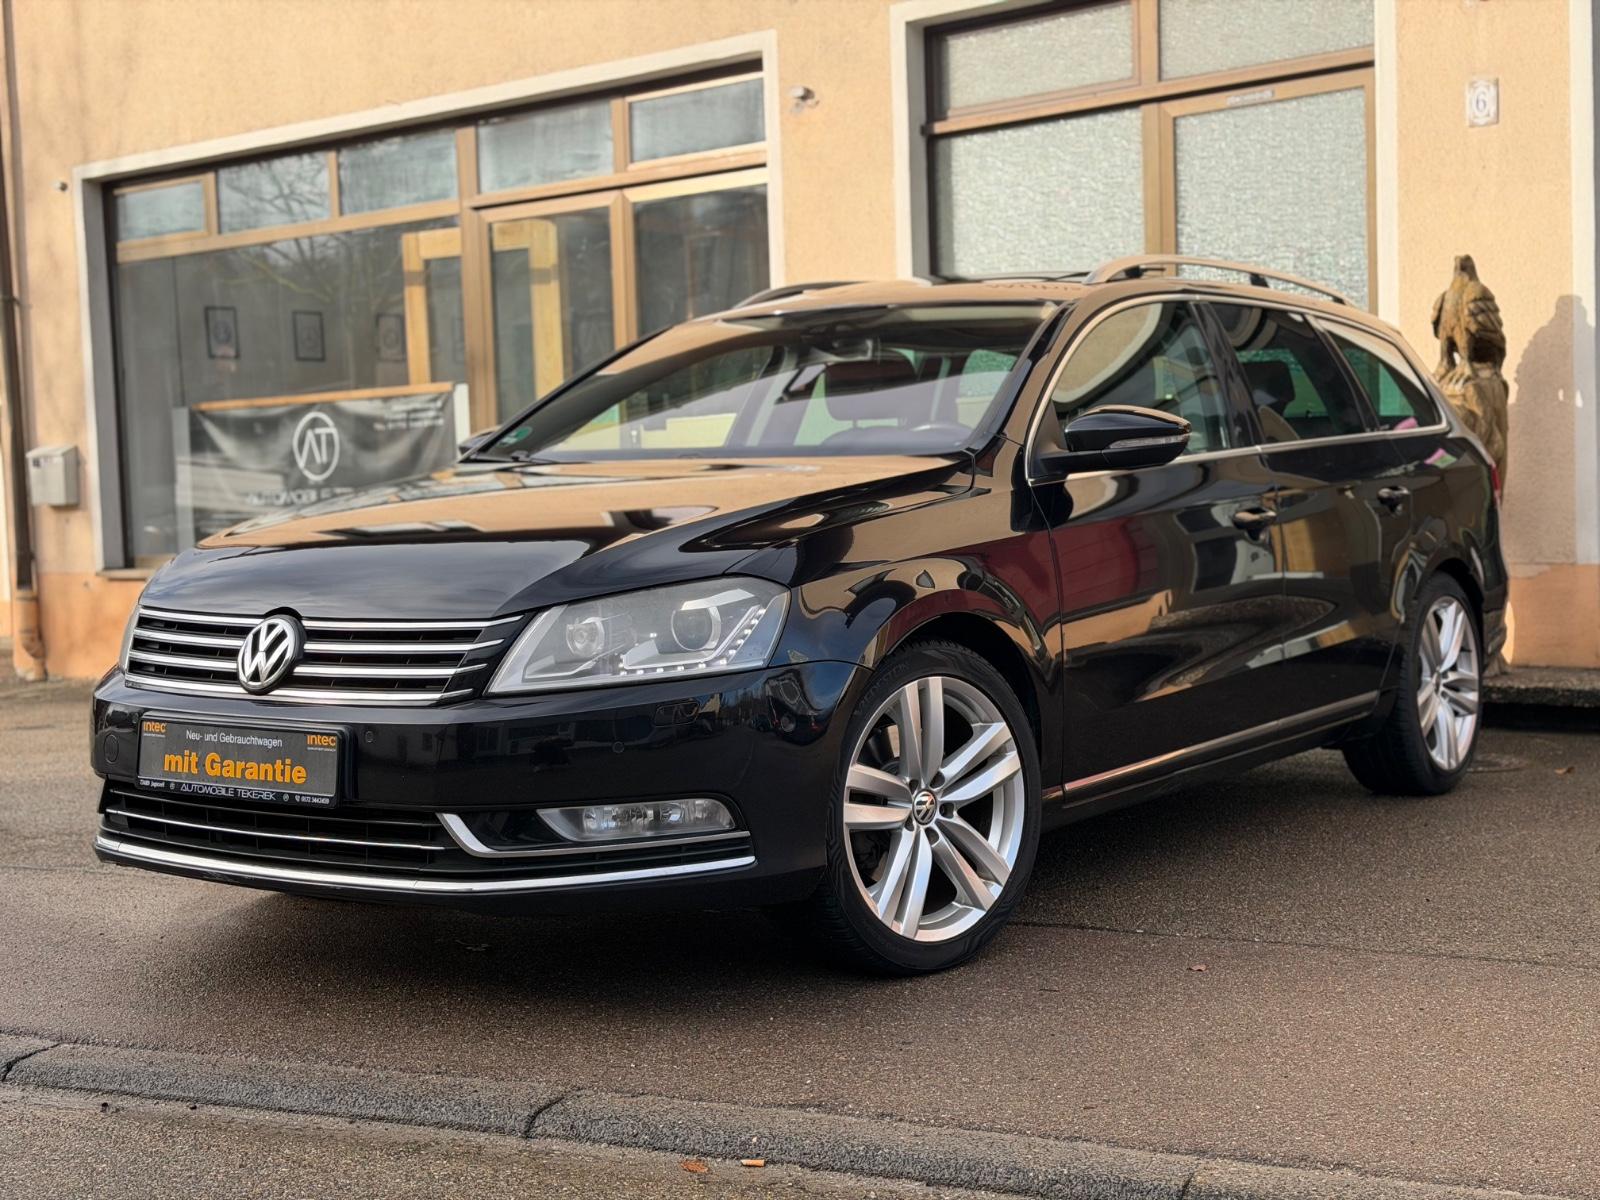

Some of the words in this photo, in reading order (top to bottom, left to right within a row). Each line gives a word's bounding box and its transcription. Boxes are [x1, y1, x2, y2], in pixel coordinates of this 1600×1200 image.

[1475, 91, 1487, 113] 6
[238, 617, 296, 690] VW
[186, 729, 203, 741] Neu-
[205, 732, 218, 742] und
[220, 733, 283, 749] Gebrauchtwagen
[164, 749, 199, 774] mit
[205, 752, 307, 784] Garantie
[181, 783, 235, 797] AUTOMOBILE
[236, 788, 277, 801] TEKEREK
